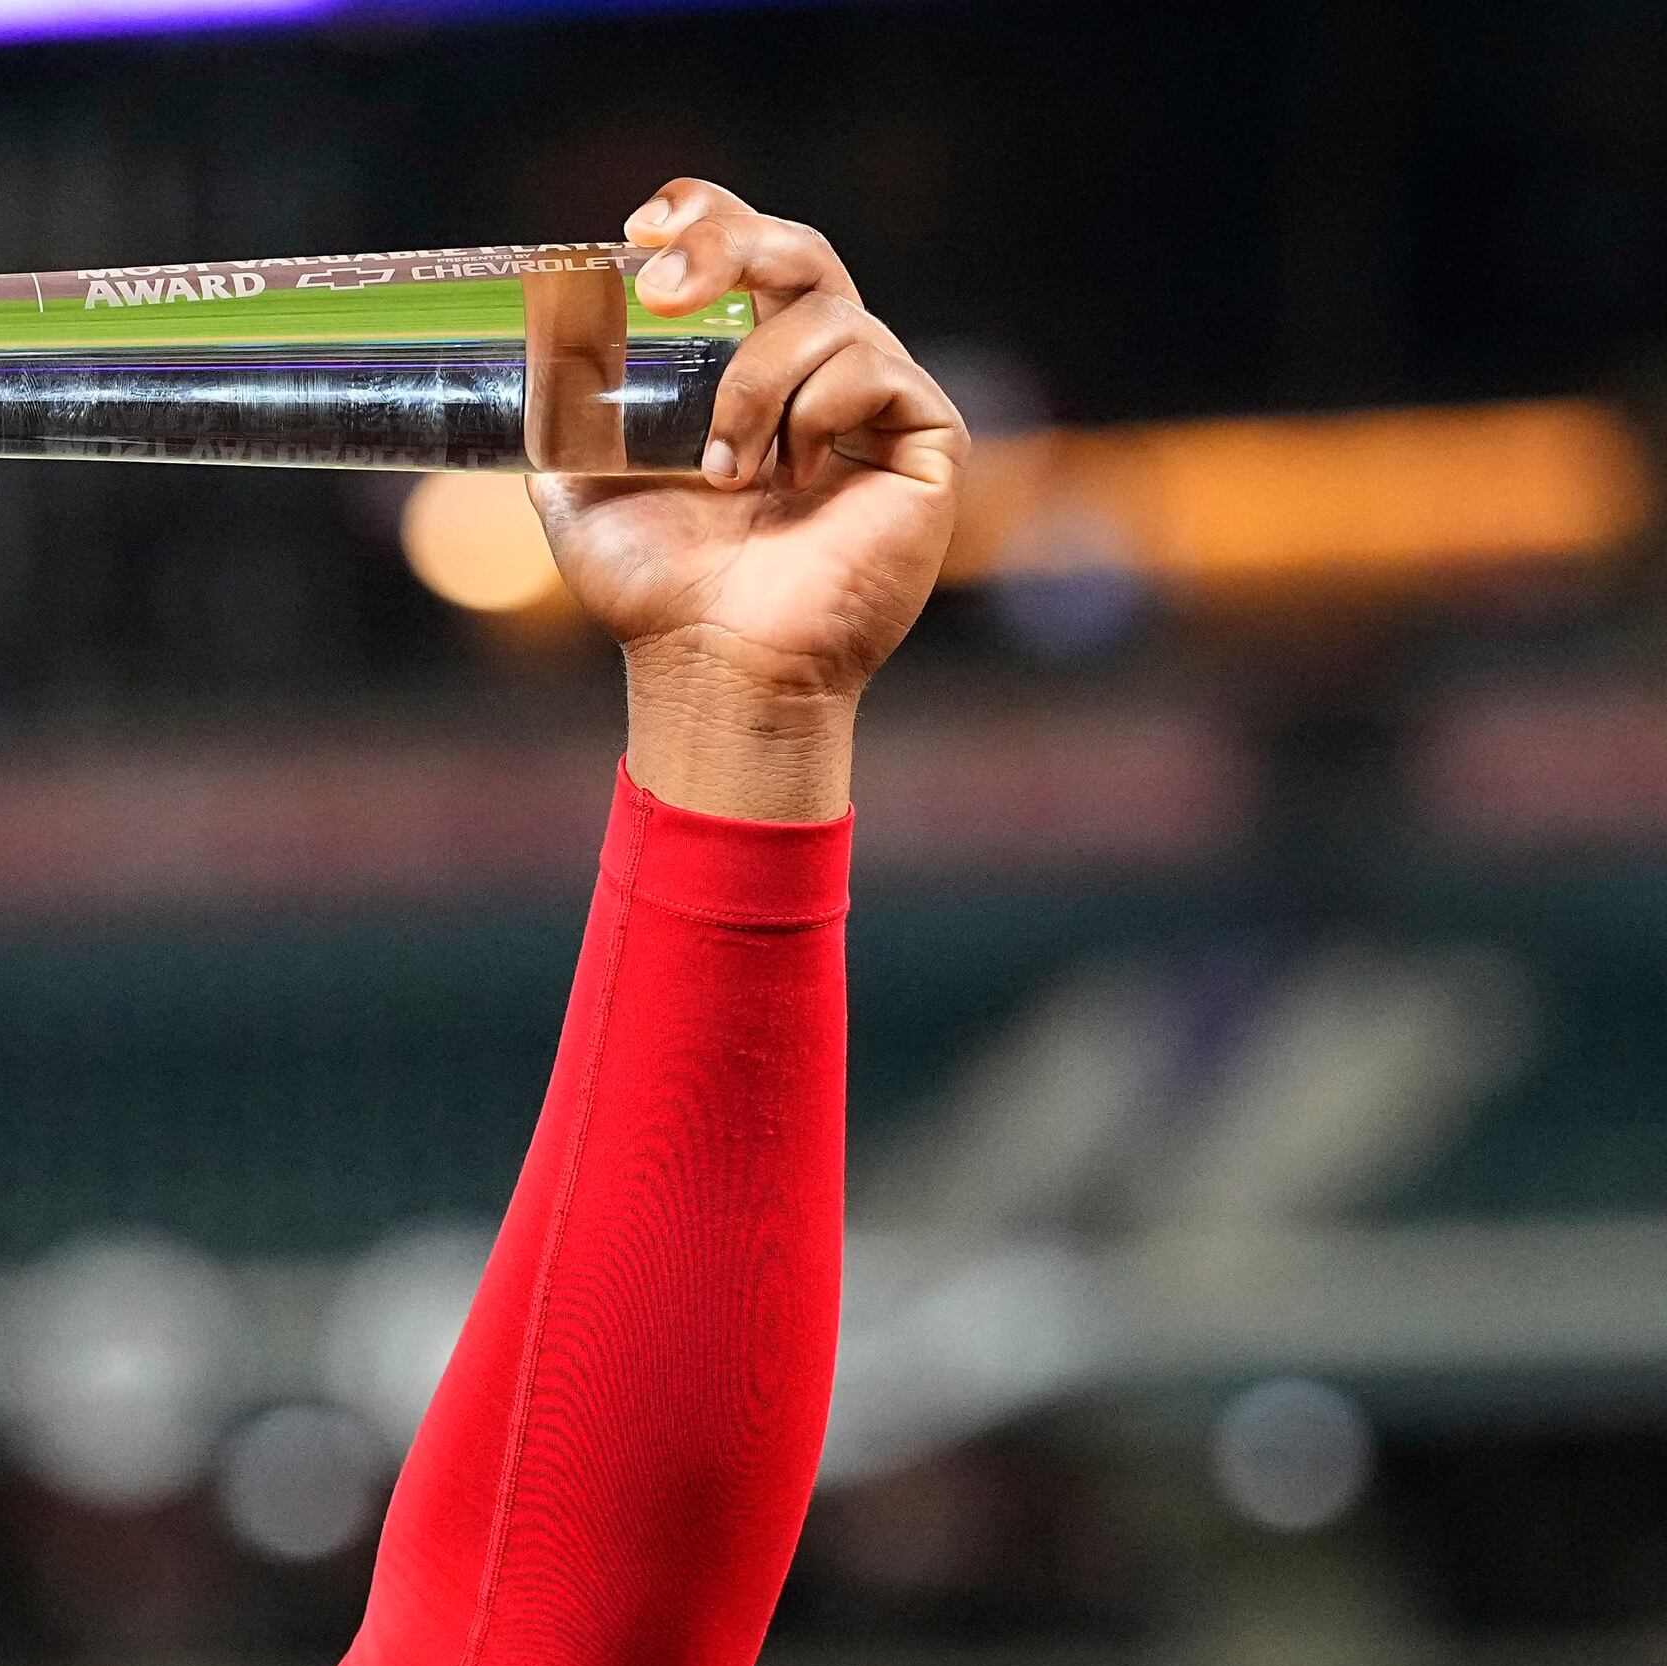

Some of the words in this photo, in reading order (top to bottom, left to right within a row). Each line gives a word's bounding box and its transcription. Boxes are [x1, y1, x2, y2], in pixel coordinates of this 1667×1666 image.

[436, 254, 513, 264] PRESENTED
[514, 252, 532, 261] BY
[478, 241, 657, 255] PLAYE
[411, 255, 631, 282] CHEVROLET
[84, 272, 266, 310] AWARD
